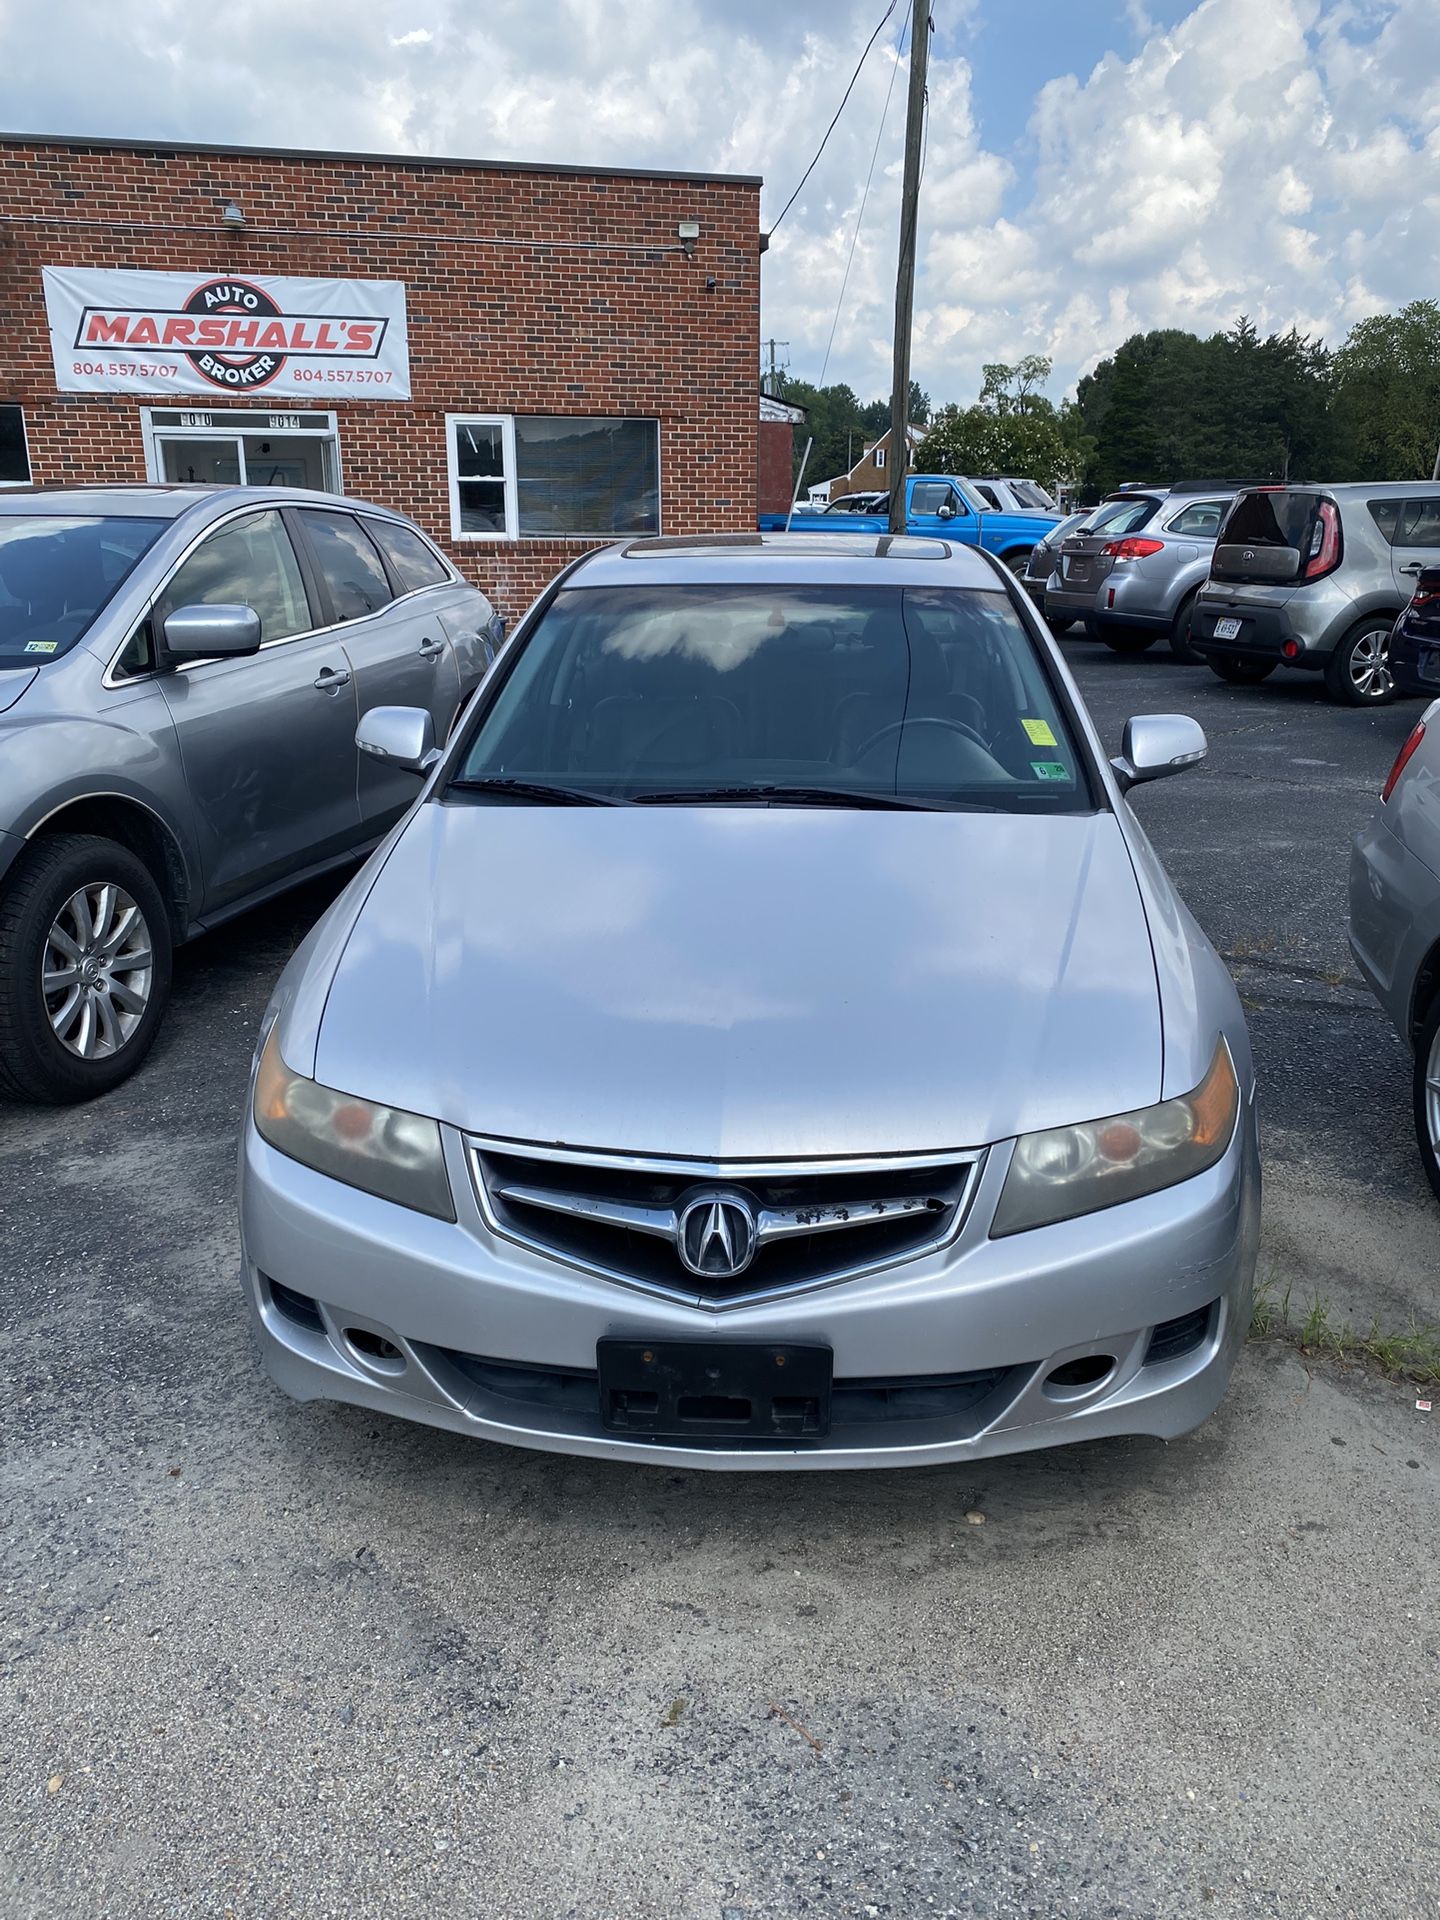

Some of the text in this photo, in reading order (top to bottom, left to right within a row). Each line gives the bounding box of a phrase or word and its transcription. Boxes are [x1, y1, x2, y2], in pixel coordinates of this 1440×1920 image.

[205, 285, 258, 310] AUTO
[85, 315, 377, 351] MARSHALL'S
[72, 362, 178, 378] 804.557.5707
[198, 354, 276, 384] BROKER
[293, 369, 393, 384] 804.557.5707
[1039, 766, 1047, 775] 6
